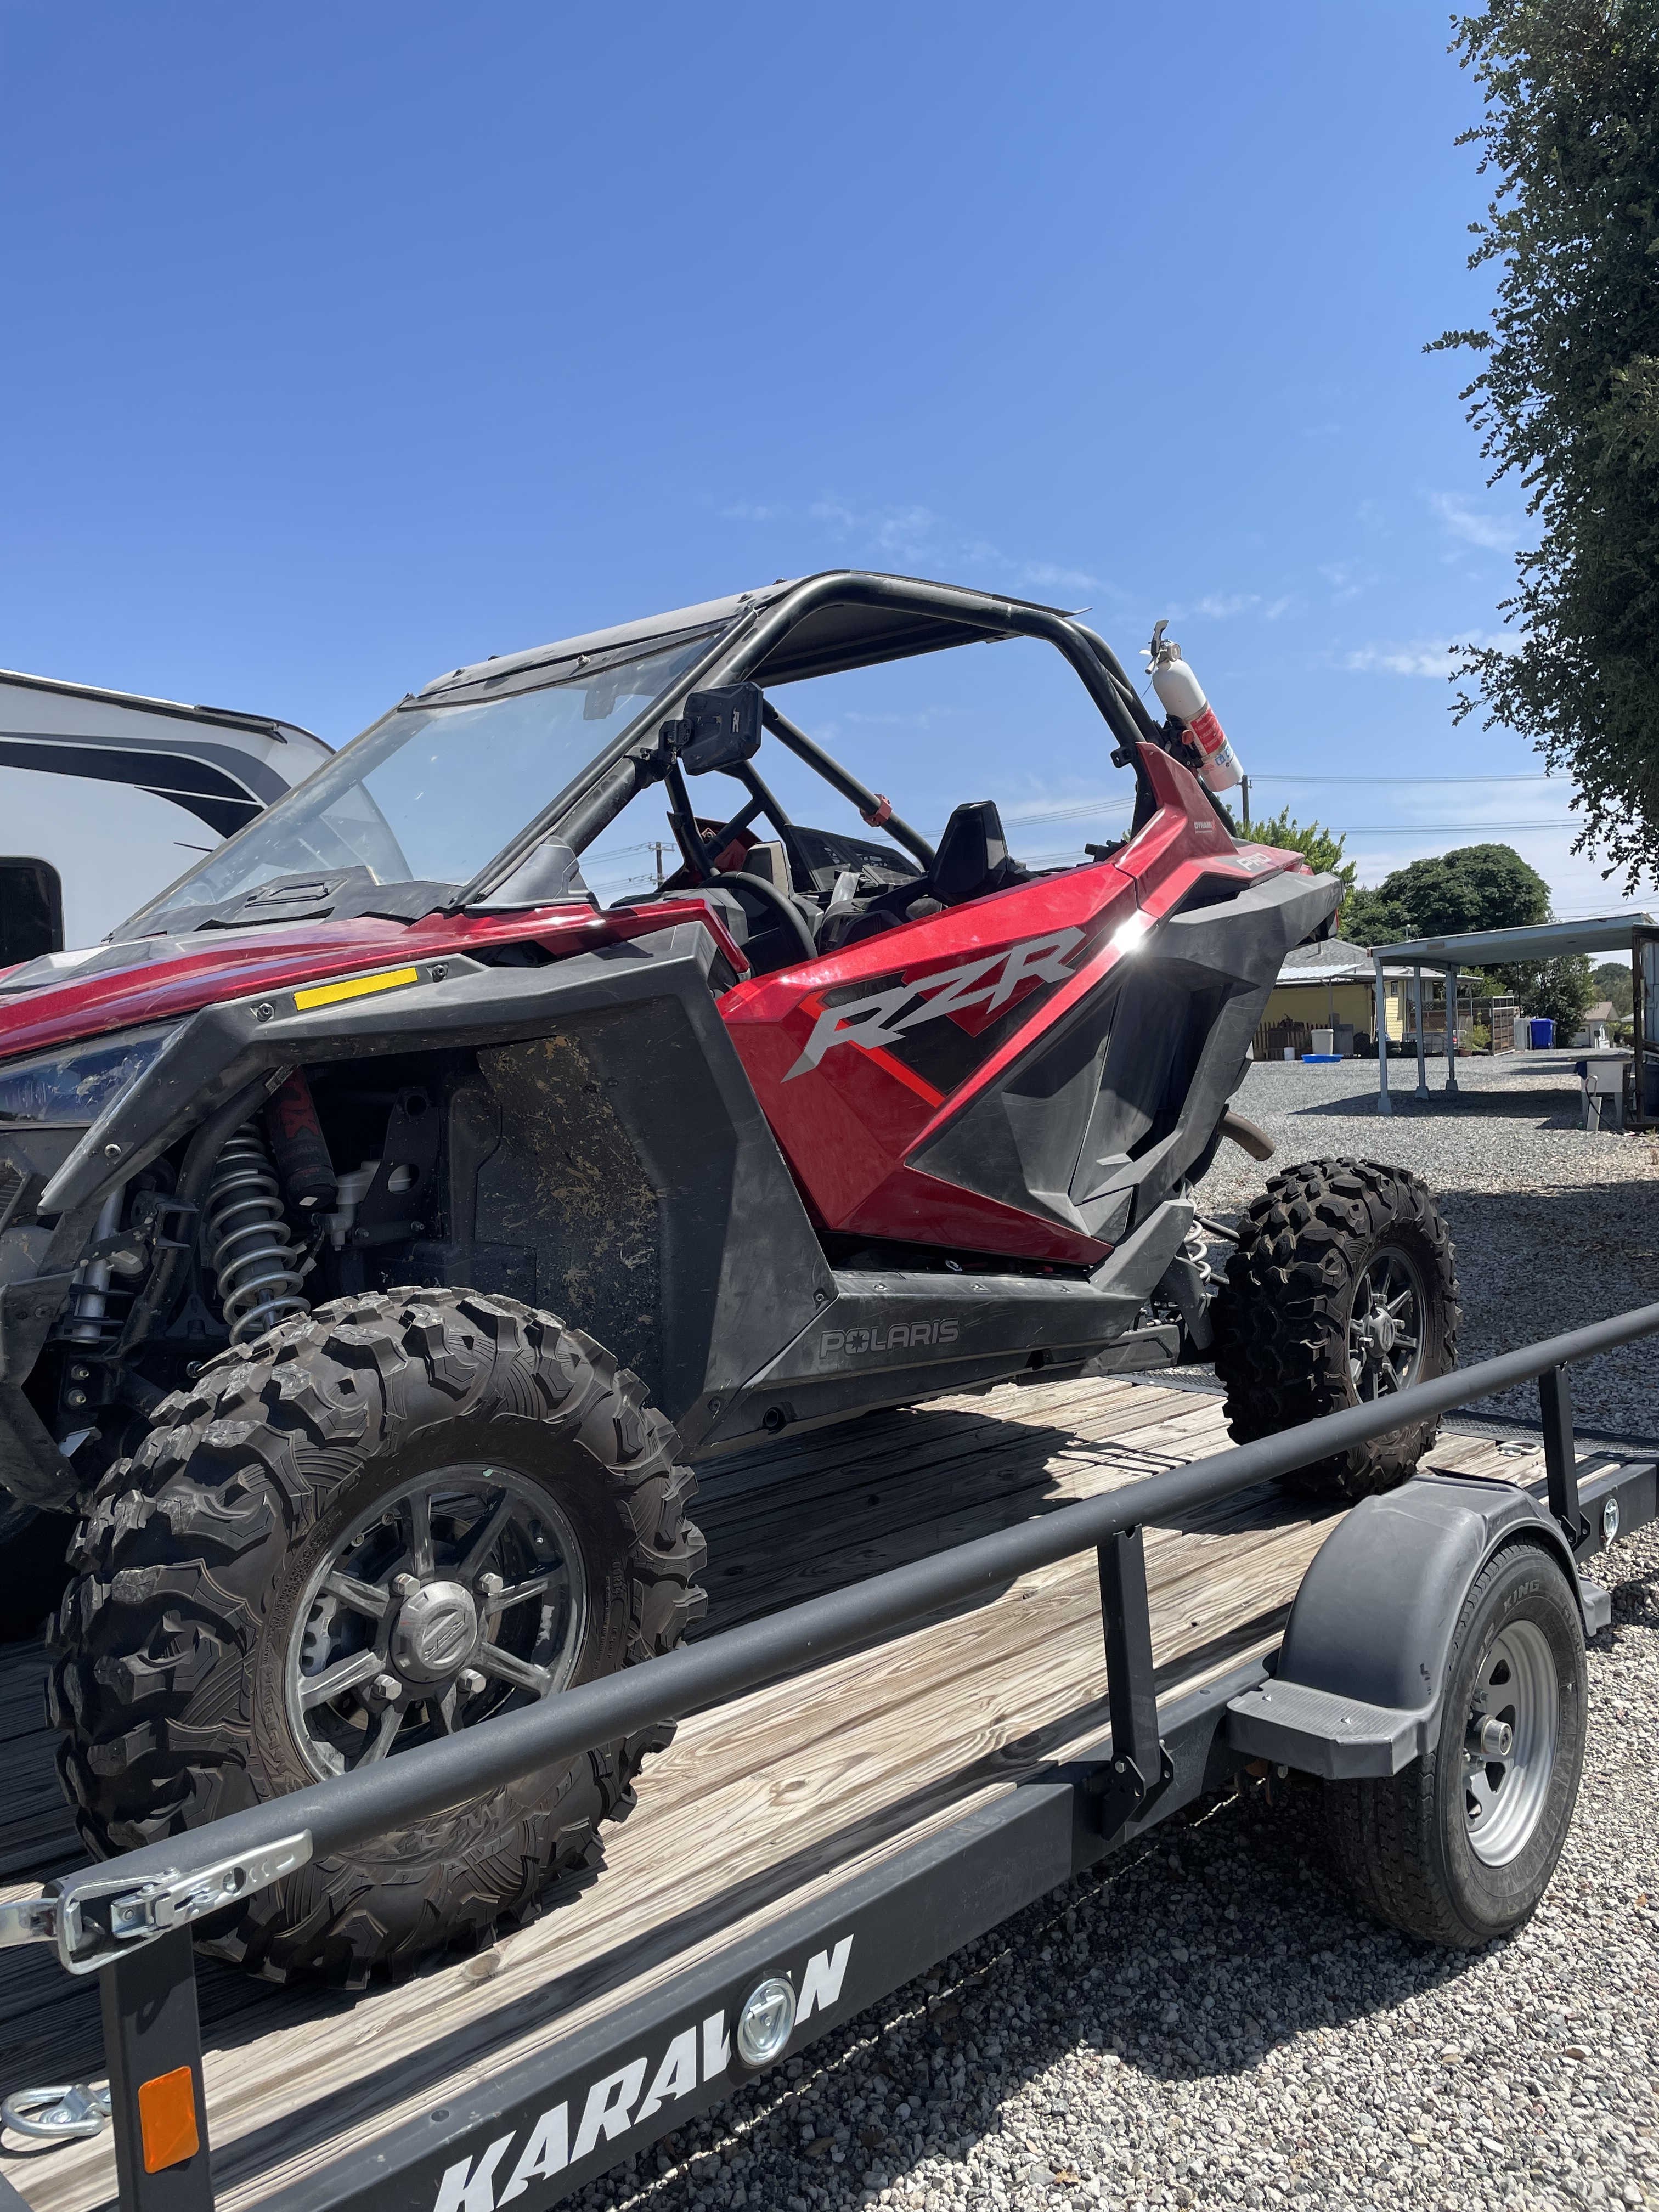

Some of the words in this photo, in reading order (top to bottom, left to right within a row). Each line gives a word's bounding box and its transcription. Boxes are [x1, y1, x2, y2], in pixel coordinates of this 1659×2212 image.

[1236, 852, 1272, 871] PRO
[781, 927, 1086, 1084] RZR
[819, 1317, 960, 1360] POLARIS
[1504, 1579, 1541, 1613] KING
[433, 1933, 854, 2212] KARAVN
